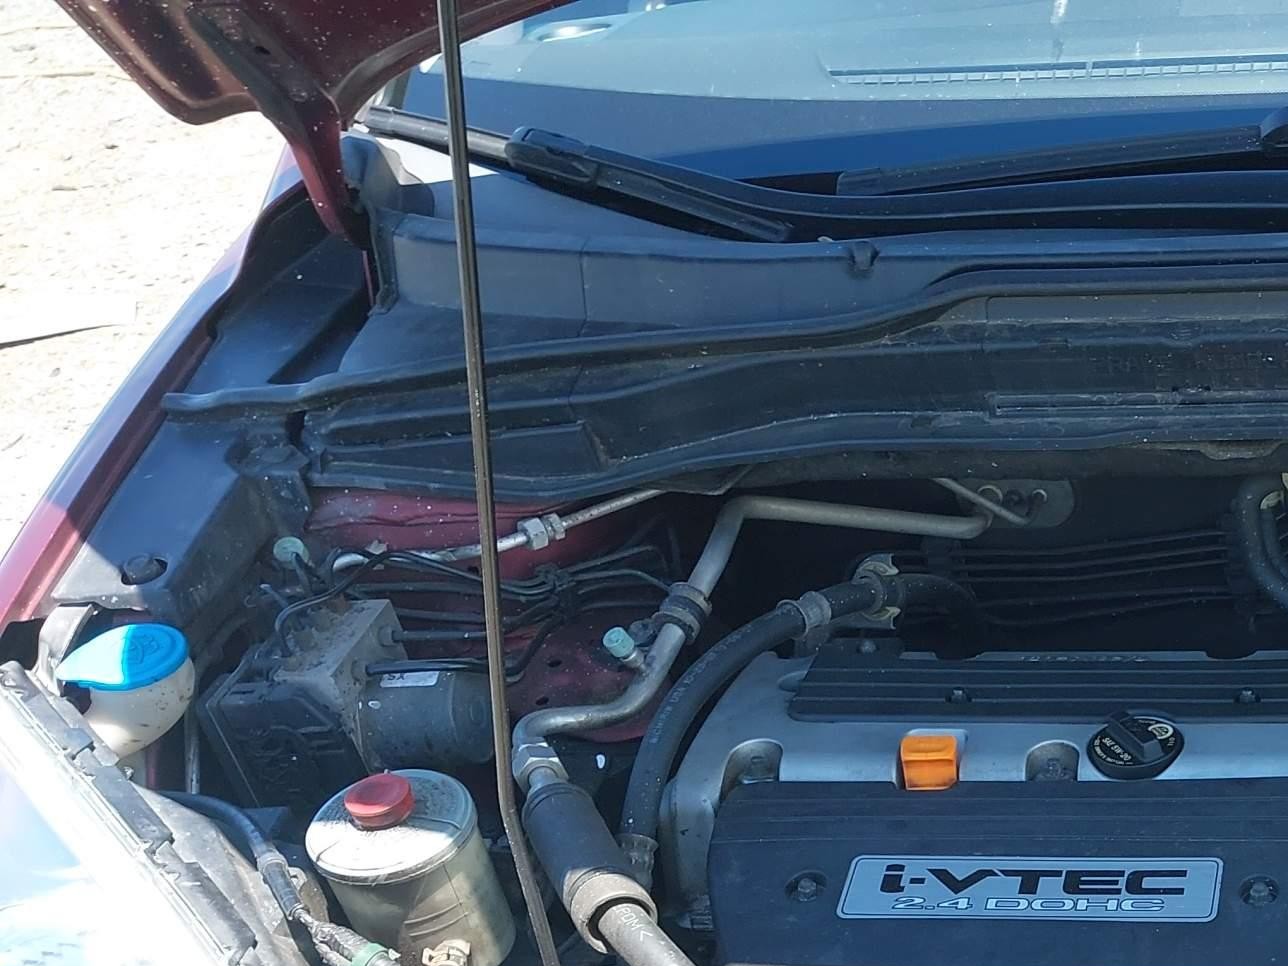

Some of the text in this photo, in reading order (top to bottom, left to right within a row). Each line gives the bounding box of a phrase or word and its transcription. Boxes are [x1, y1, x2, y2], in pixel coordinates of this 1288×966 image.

[879, 863, 1188, 895] i-VTEC
[891, 896, 1166, 912] 2.4 DOHC
